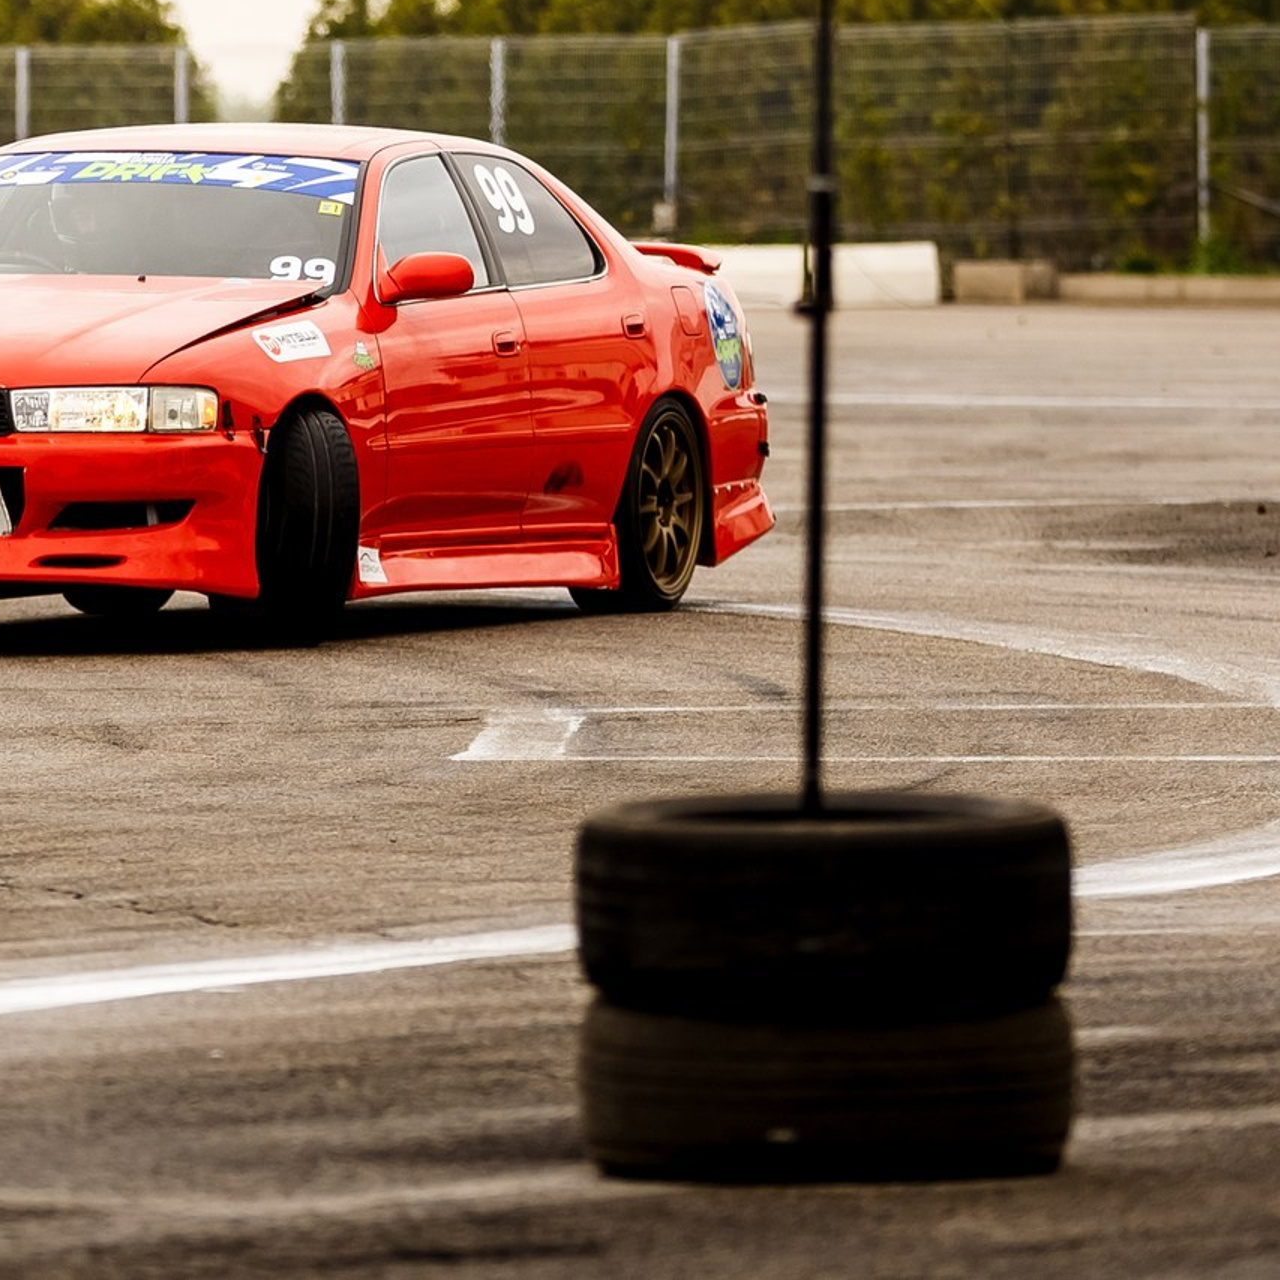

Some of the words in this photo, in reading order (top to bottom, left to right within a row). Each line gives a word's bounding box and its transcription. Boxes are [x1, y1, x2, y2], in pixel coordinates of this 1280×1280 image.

[71, 161, 217, 184] DRIFT
[474, 164, 535, 235] 99
[269, 255, 336, 286] 99
